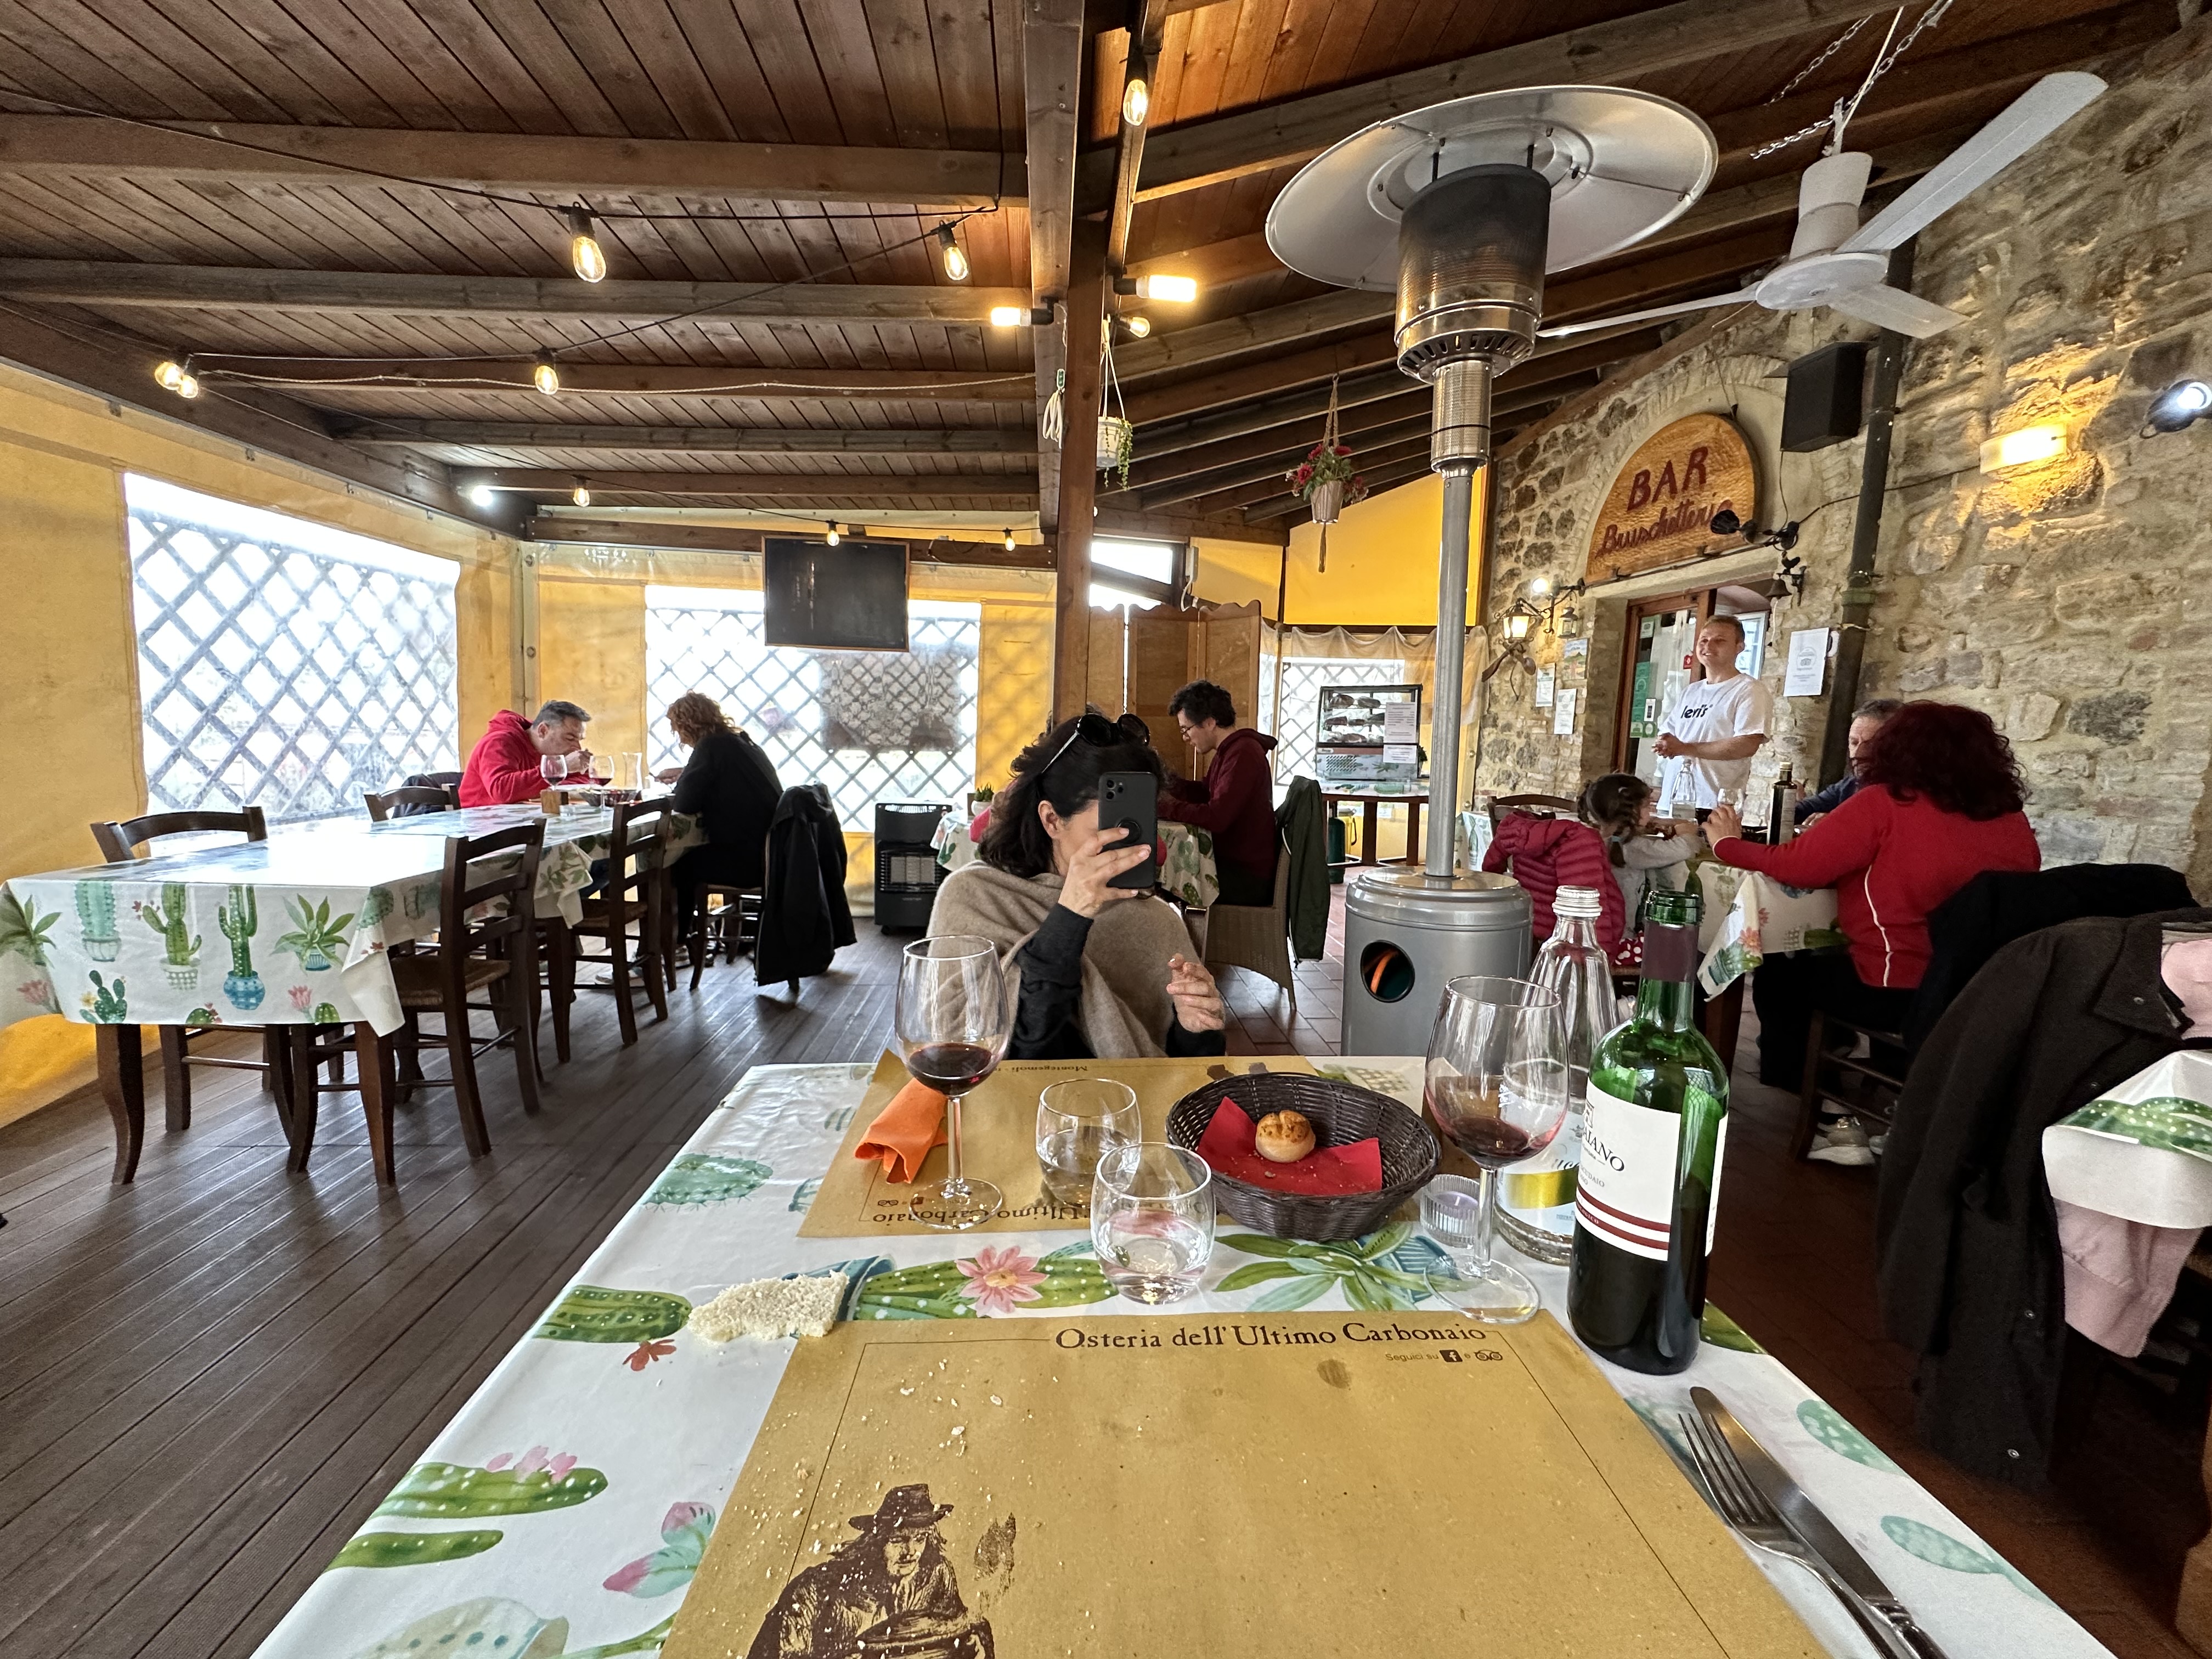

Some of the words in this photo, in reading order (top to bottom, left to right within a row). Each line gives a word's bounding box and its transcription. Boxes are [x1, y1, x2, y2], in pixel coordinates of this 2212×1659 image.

[1627, 446, 1708, 511] BAR
[1594, 492, 1733, 560] Bruschetteri
[1583, 1126, 1625, 1172] AIANO
[1056, 1328, 1161, 1348] Osteria
[1342, 1323, 1486, 1342] Carbonaio
[1385, 1353, 1423, 1362] Seguici
